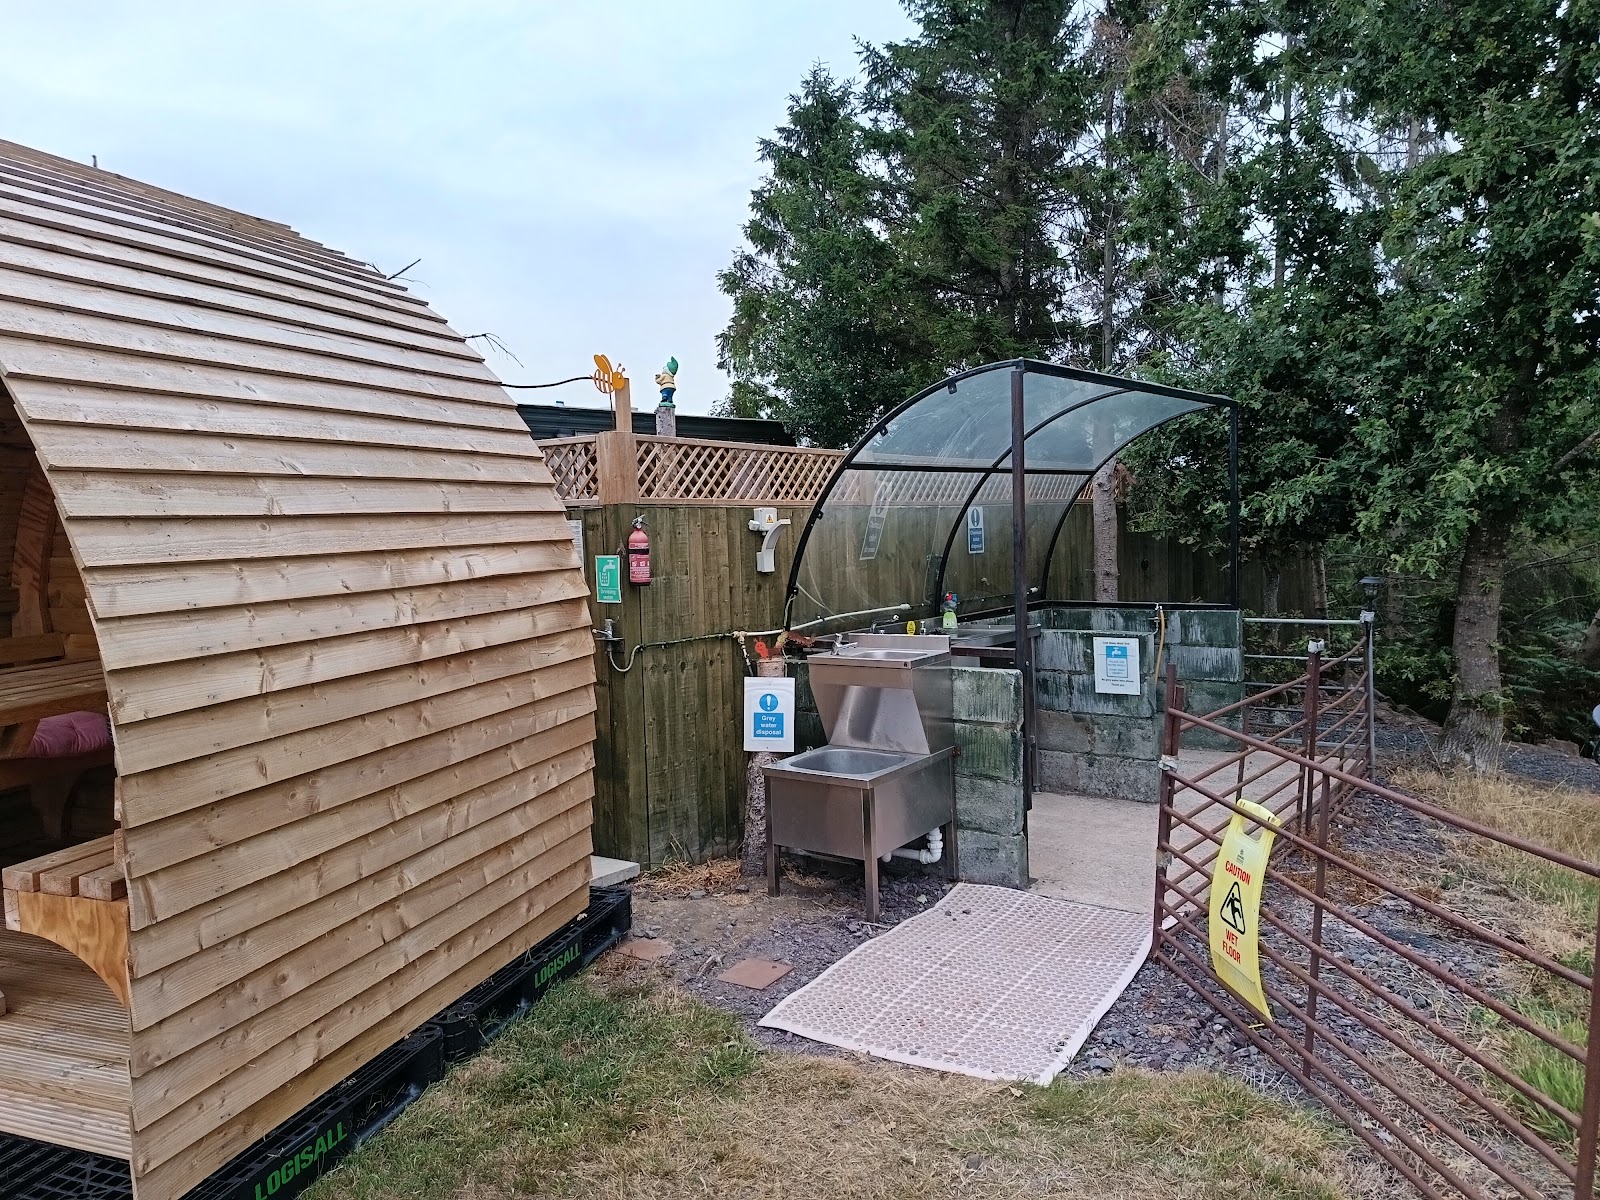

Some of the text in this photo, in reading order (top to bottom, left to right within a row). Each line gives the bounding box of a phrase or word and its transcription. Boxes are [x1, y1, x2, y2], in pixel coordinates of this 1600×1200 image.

[1225, 860, 1251, 885] CAUTION
[1225, 928, 1238, 947] WET
[1222, 940, 1241, 965] FLOOR
[534, 943, 581, 989] LOGISALL
[254, 1121, 348, 1200] LOGISALL
